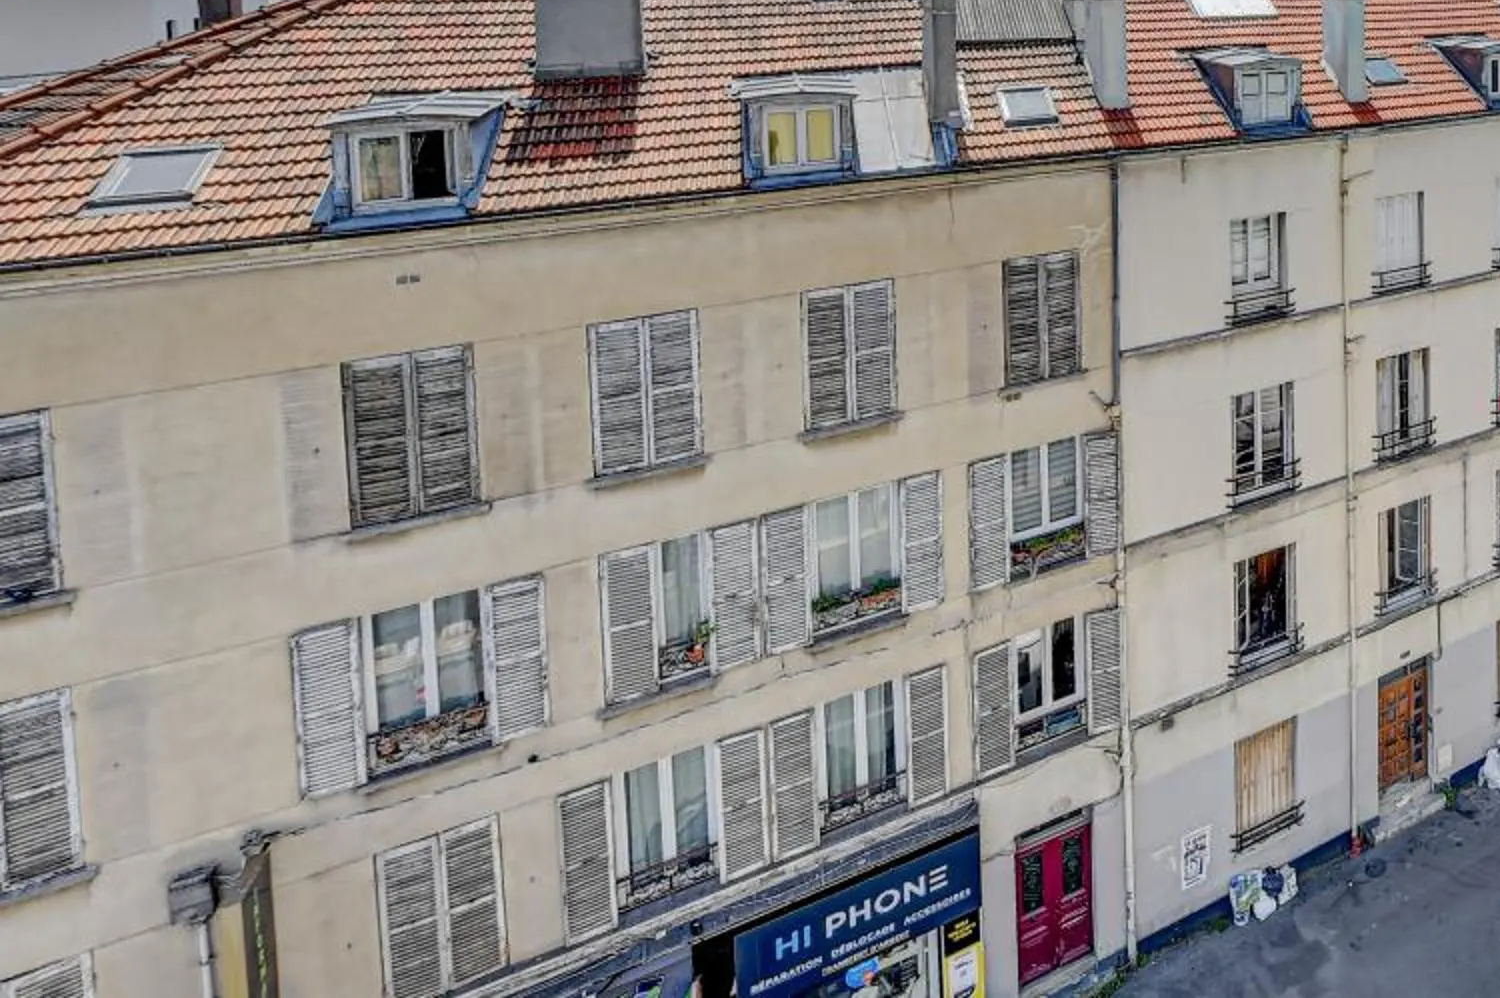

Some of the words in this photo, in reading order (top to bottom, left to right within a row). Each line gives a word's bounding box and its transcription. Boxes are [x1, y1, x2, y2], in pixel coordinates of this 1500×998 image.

[751, 955, 823, 995] RÉPARATION
[831, 922, 895, 959] DÉBLOCAGE
[903, 887, 972, 927] ACCESSOIRES
[775, 924, 811, 961] HI
[825, 864, 949, 939] PHONE
